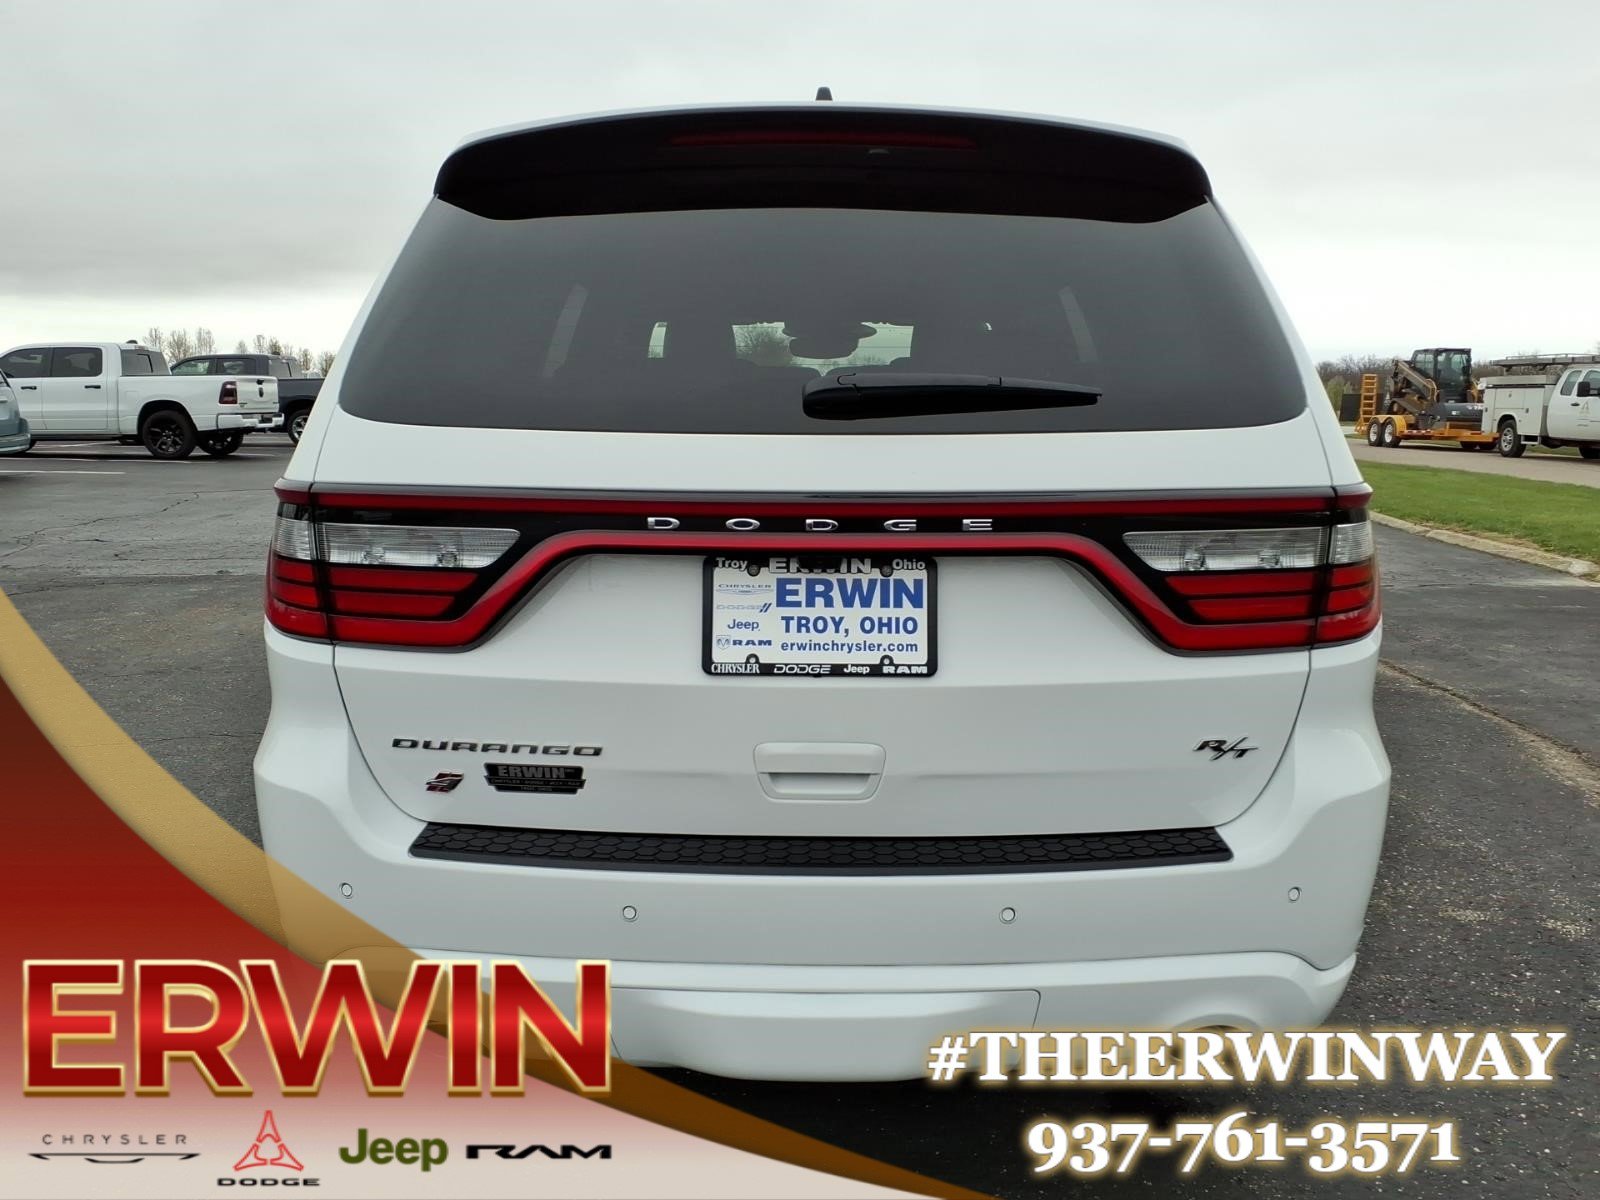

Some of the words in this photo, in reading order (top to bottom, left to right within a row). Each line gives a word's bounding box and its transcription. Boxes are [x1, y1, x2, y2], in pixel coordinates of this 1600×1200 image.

[647, 516, 993, 532] DODGE
[715, 557, 748, 571] Troy
[769, 557, 872, 574] ERIN
[892, 558, 926, 571] Ohio
[775, 577, 924, 608] ERWIN
[727, 618, 760, 632] Jeep
[780, 616, 850, 637] TROY,
[859, 616, 919, 635] OHIO
[732, 638, 772, 647] RAM
[780, 640, 918, 654] erwinchrysler.com
[711, 663, 760, 674] CHRYSLER
[773, 664, 832, 674] DODGE
[843, 664, 870, 675] Jeep
[883, 665, 928, 674] RAM
[392, 738, 603, 757] DURANGO
[1192, 736, 1259, 761] R/T
[497, 765, 566, 779] ERWIN
